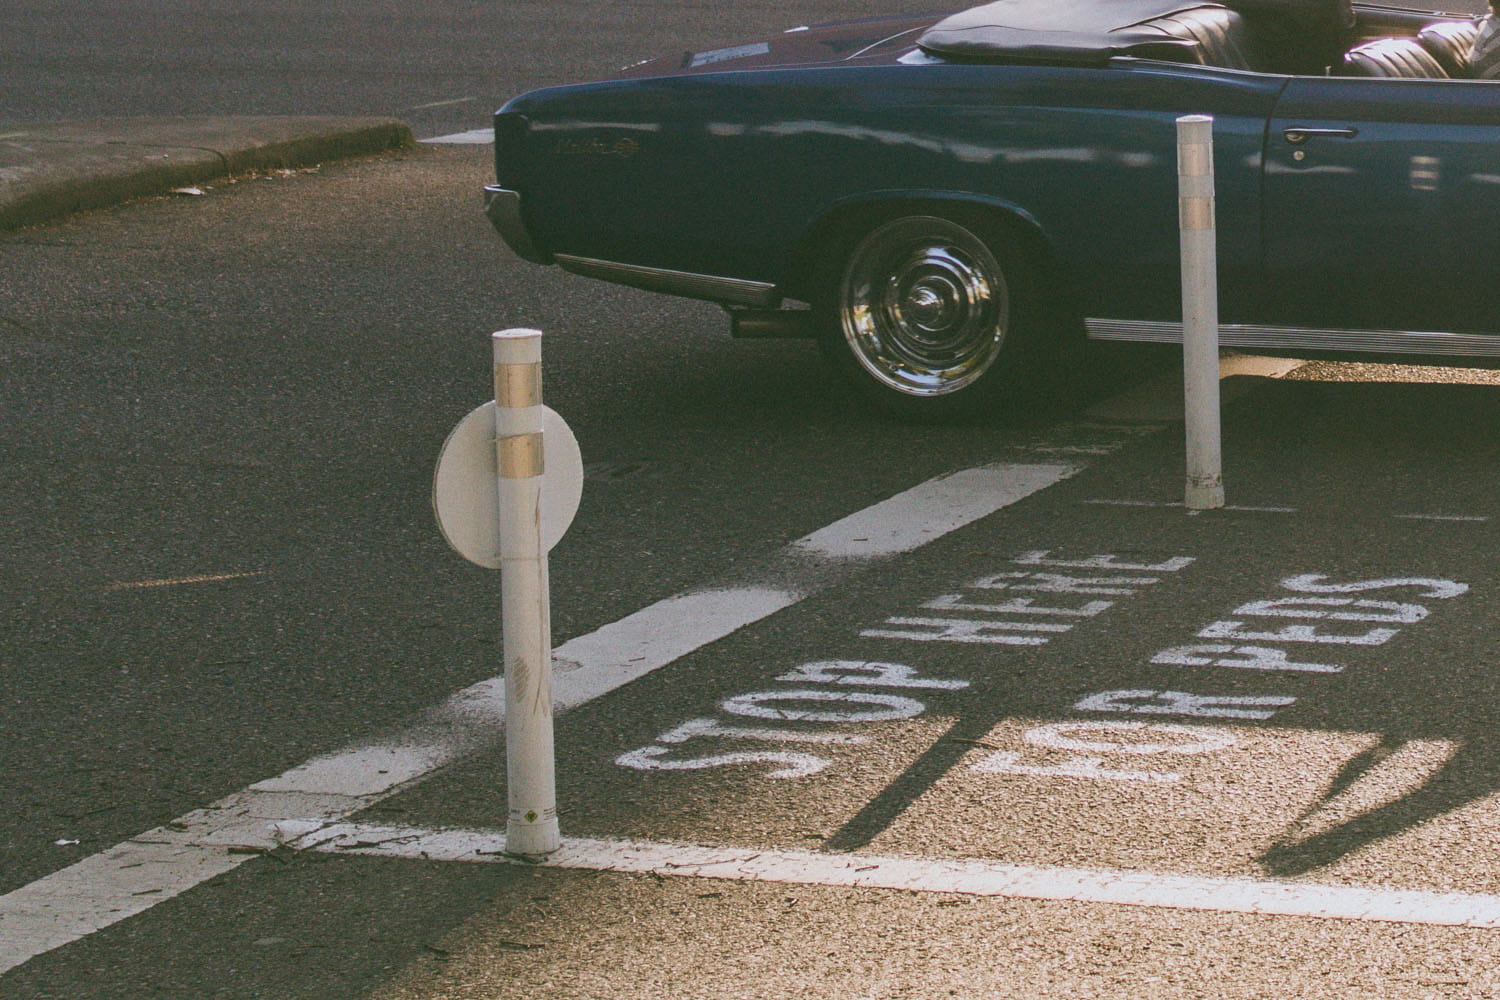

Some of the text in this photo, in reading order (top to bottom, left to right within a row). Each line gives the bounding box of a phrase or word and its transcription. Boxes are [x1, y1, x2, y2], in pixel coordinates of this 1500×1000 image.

[614, 550, 1197, 778] STOP HERE
[969, 574, 1470, 781] FOR PEDS
